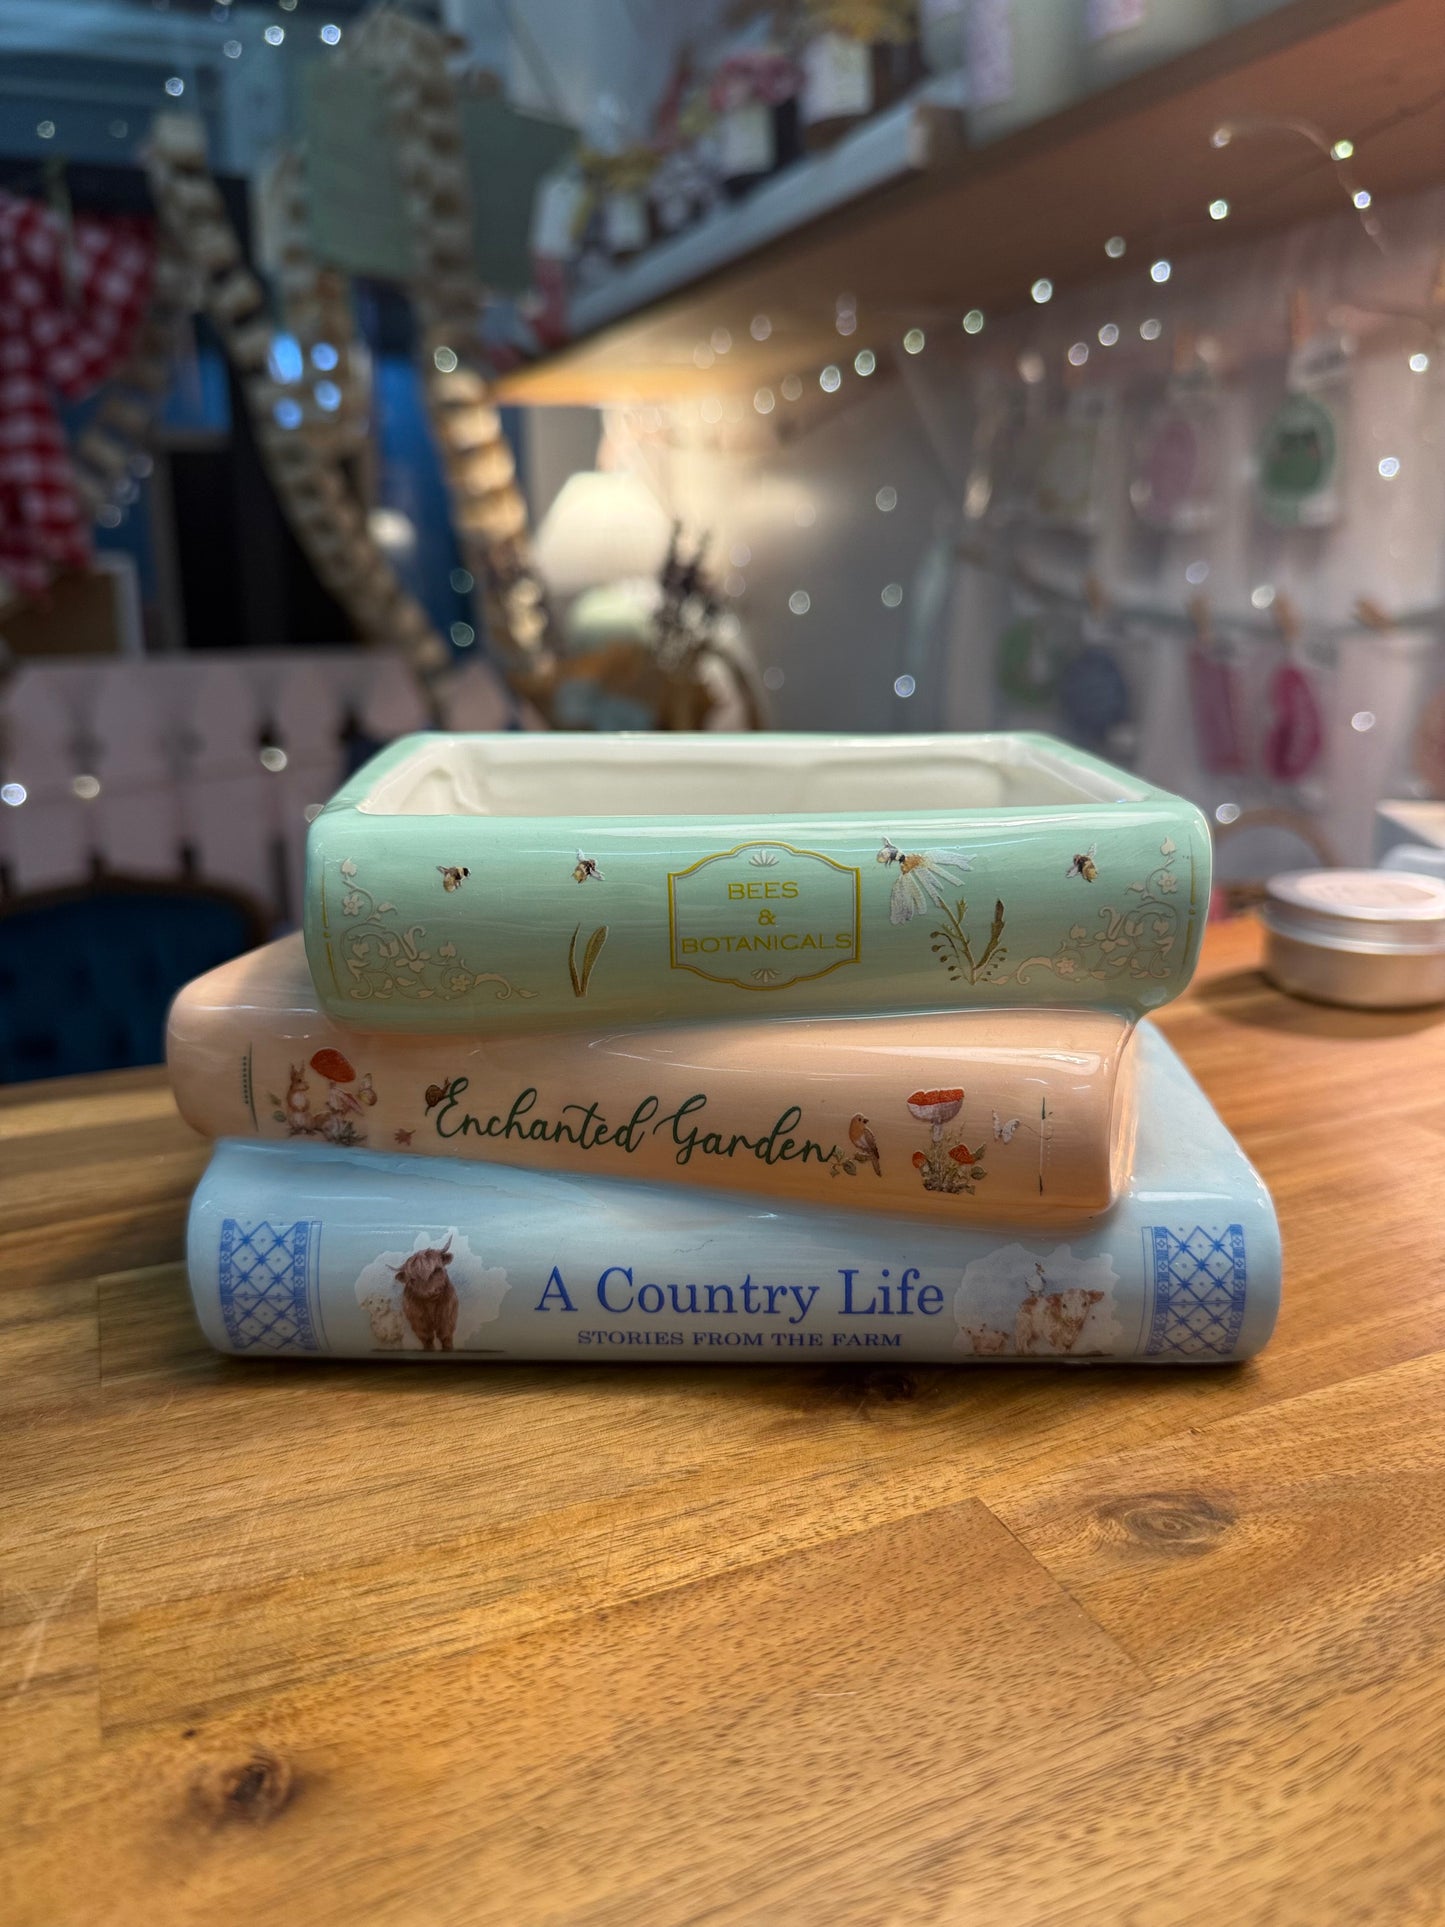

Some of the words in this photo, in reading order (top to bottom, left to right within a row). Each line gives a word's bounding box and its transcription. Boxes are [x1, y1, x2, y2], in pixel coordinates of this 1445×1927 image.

[728, 881, 799, 900] BEES
[757, 908, 776, 926] &
[681, 933, 852, 954] BOTANICALS
[436, 1077, 659, 1154] Enchanted
[653, 1094, 837, 1165] Garden
[534, 1265, 578, 1312] A
[597, 1266, 820, 1324] Country
[838, 1268, 944, 1315] Life
[578, 1330, 684, 1345] STORIES
[693, 1331, 763, 1346] FROM
[771, 1333, 823, 1346] THE
[833, 1333, 902, 1346] FARM
